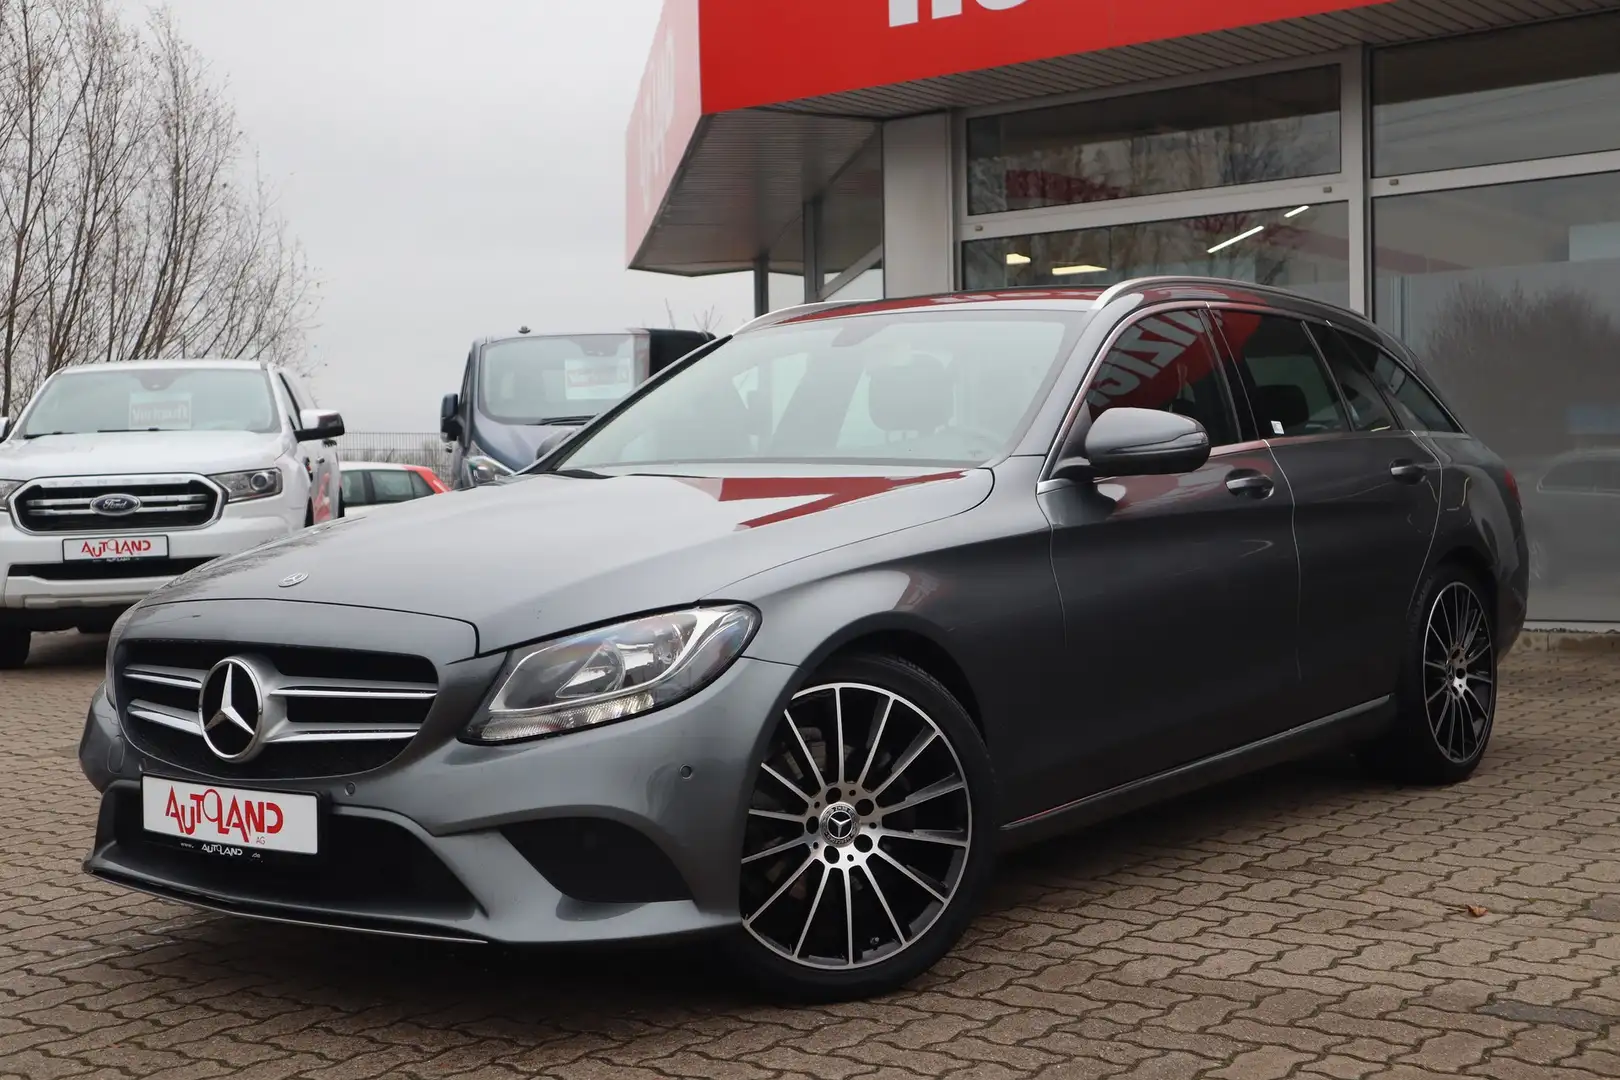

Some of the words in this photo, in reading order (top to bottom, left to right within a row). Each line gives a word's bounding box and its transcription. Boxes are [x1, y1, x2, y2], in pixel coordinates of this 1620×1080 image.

[103, 499, 127, 509] Ford
[81, 539, 151, 557] AUTOLAND
[165, 785, 284, 843] AUTOLAND
